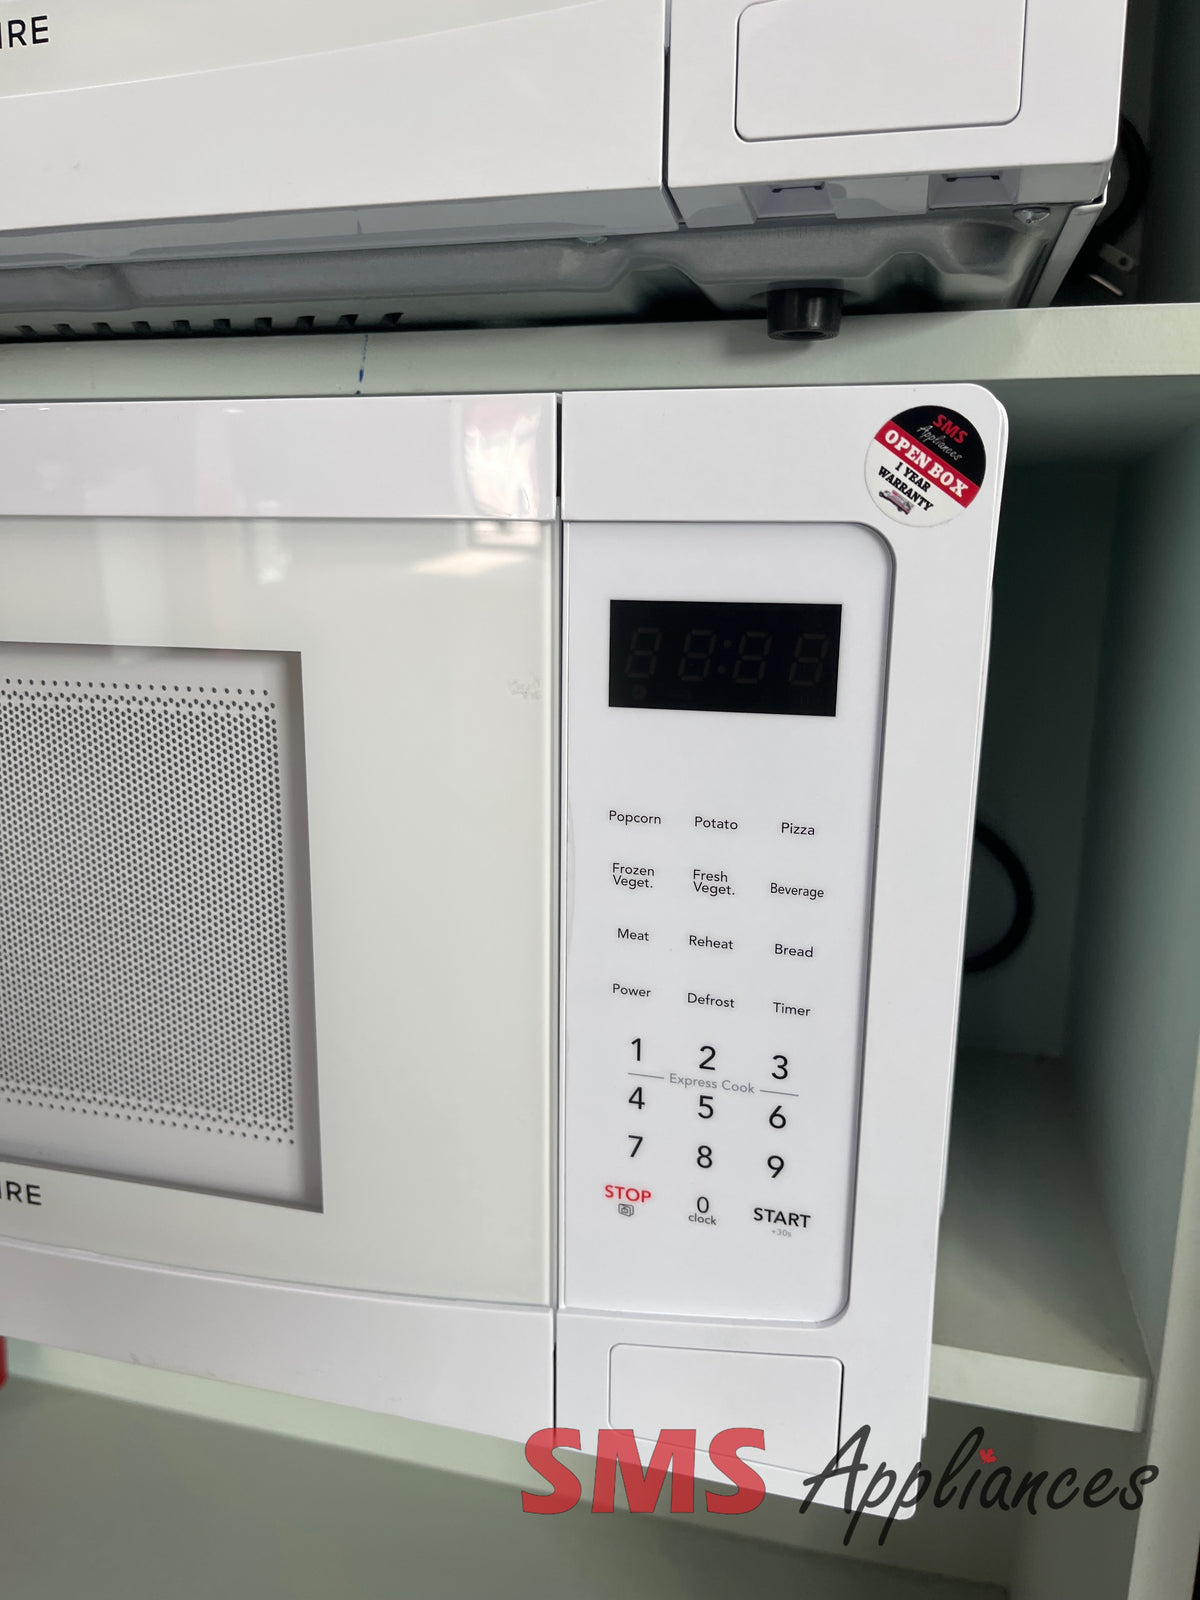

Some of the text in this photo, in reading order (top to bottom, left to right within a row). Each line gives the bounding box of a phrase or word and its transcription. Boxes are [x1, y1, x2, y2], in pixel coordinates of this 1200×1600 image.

[933, 414, 968, 443] SMS
[916, 425, 962, 461] Appliances
[885, 430, 968, 498] OPEN BOX
[902, 466, 931, 492] YEAR
[878, 466, 934, 511] WARRANTY
[609, 810, 661, 826] Popcorn
[695, 816, 738, 830] Potato
[782, 822, 814, 835] Pizza
[611, 862, 655, 877] Frozen
[692, 869, 729, 882] Fresh
[612, 875, 653, 890] Veget.
[693, 881, 735, 896] Veget.
[771, 882, 824, 900] Beverage
[618, 928, 649, 941] Meat
[689, 935, 733, 949] Reheat
[775, 944, 813, 957] Bread
[613, 983, 651, 997] Power
[688, 993, 734, 1008] Defrost
[773, 1002, 811, 1016] Timer
[631, 1038, 641, 1061] 1
[699, 1046, 716, 1070] 2
[772, 1055, 788, 1080] 3
[669, 1073, 755, 1094] Express Cook
[628, 1087, 645, 1110] 4
[698, 1095, 714, 1119] 5
[769, 1105, 786, 1129] 6
[628, 1135, 643, 1158] 7
[697, 1145, 712, 1168] 8
[767, 1155, 784, 1178] 9
[604, 1184, 652, 1203] STOP
[696, 1196, 710, 1214] 0
[688, 1213, 717, 1226] clock
[753, 1207, 811, 1228] START
[771, 1229, 792, 1238] +30s
